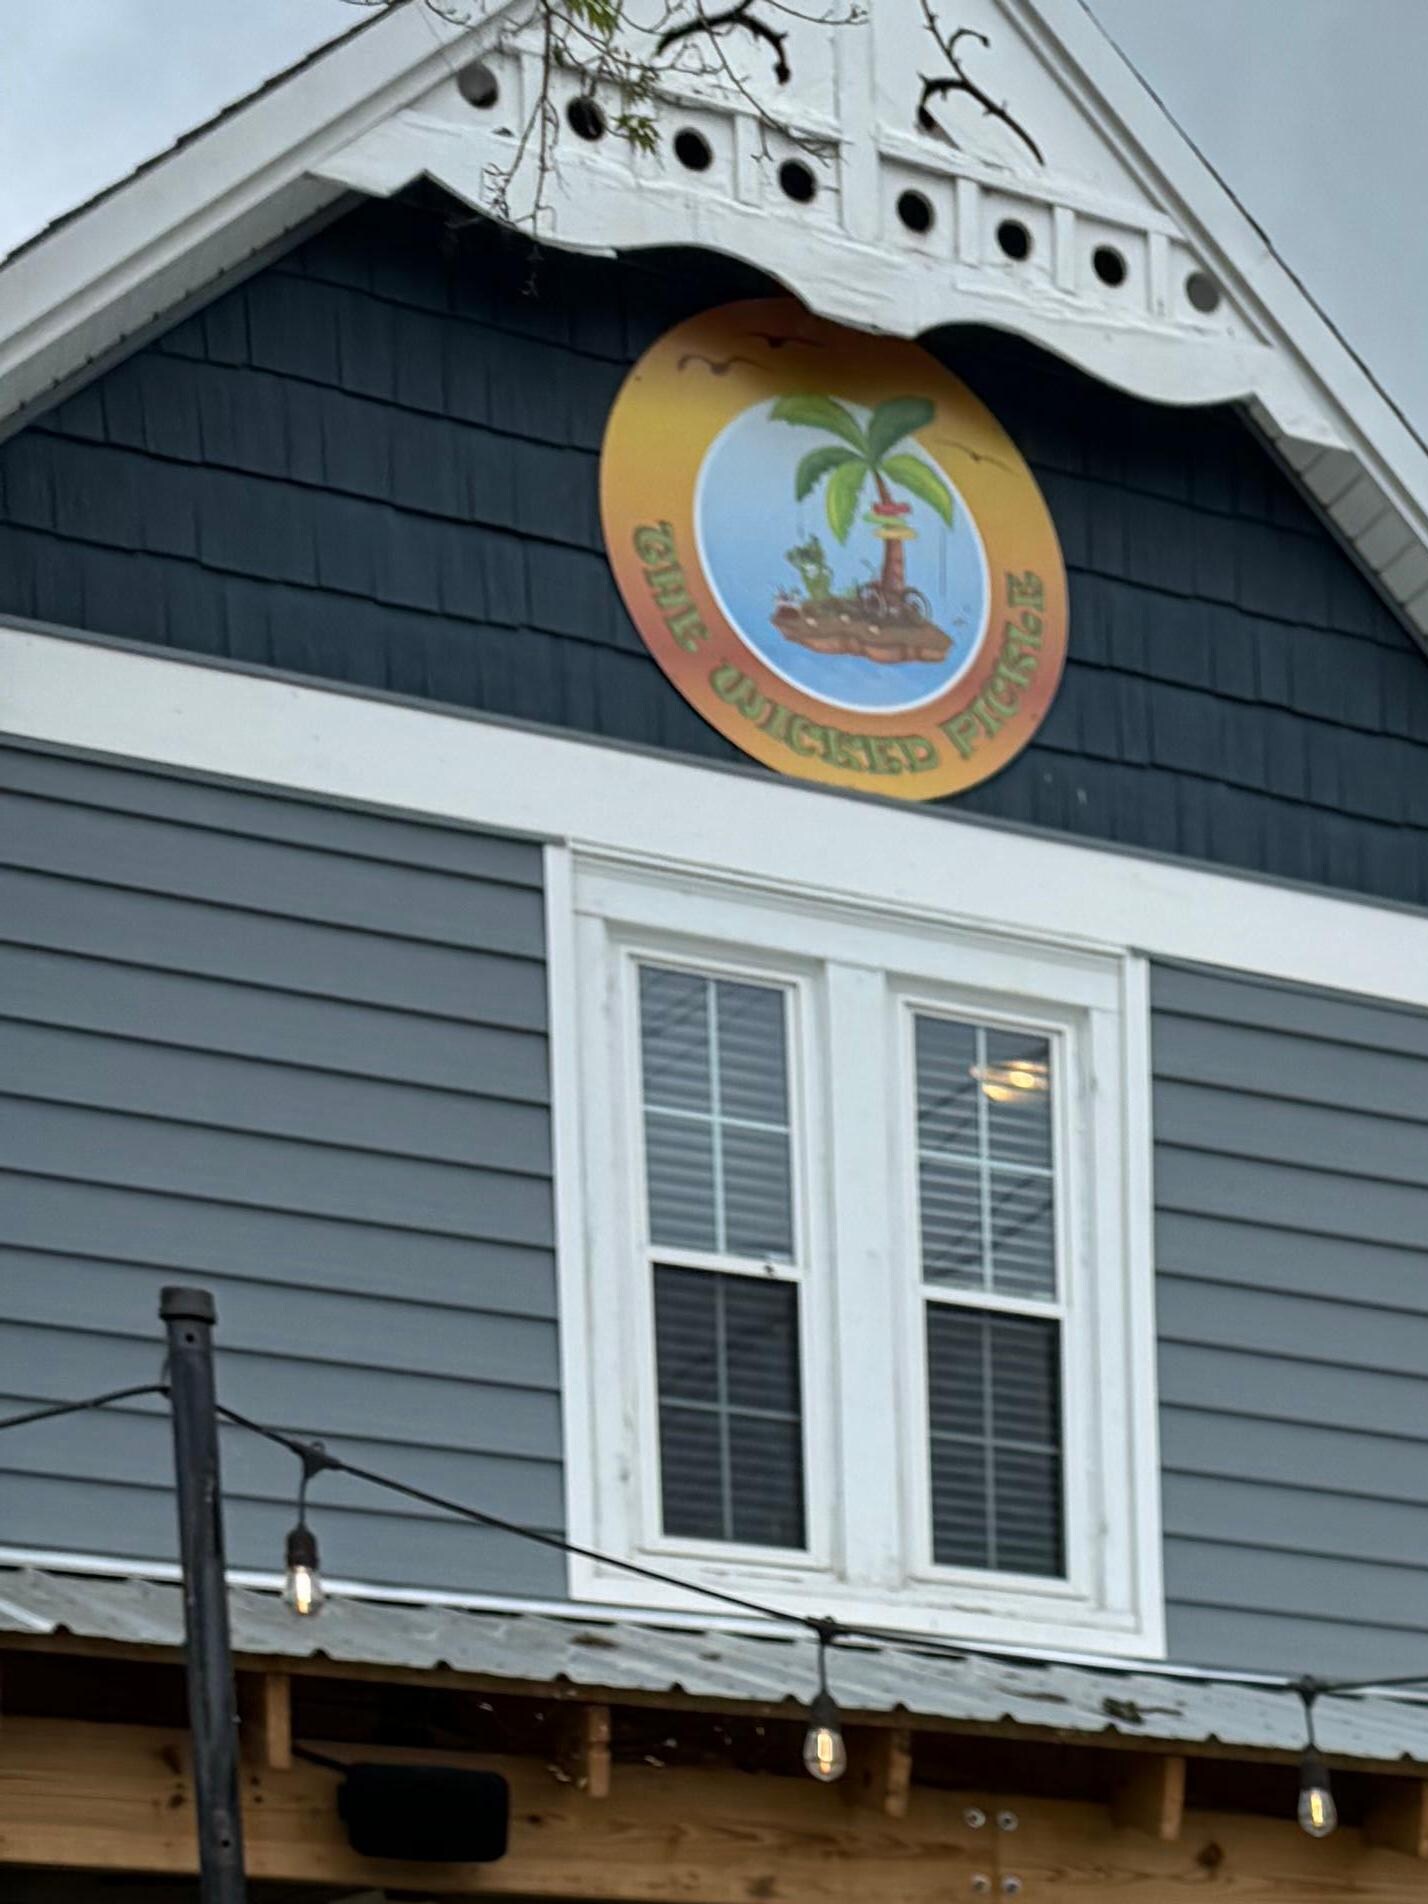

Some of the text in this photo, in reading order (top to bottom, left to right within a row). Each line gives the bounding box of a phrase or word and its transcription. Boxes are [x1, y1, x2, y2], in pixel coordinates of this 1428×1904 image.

[633, 520, 1045, 777] THE WICKED PICKLE
